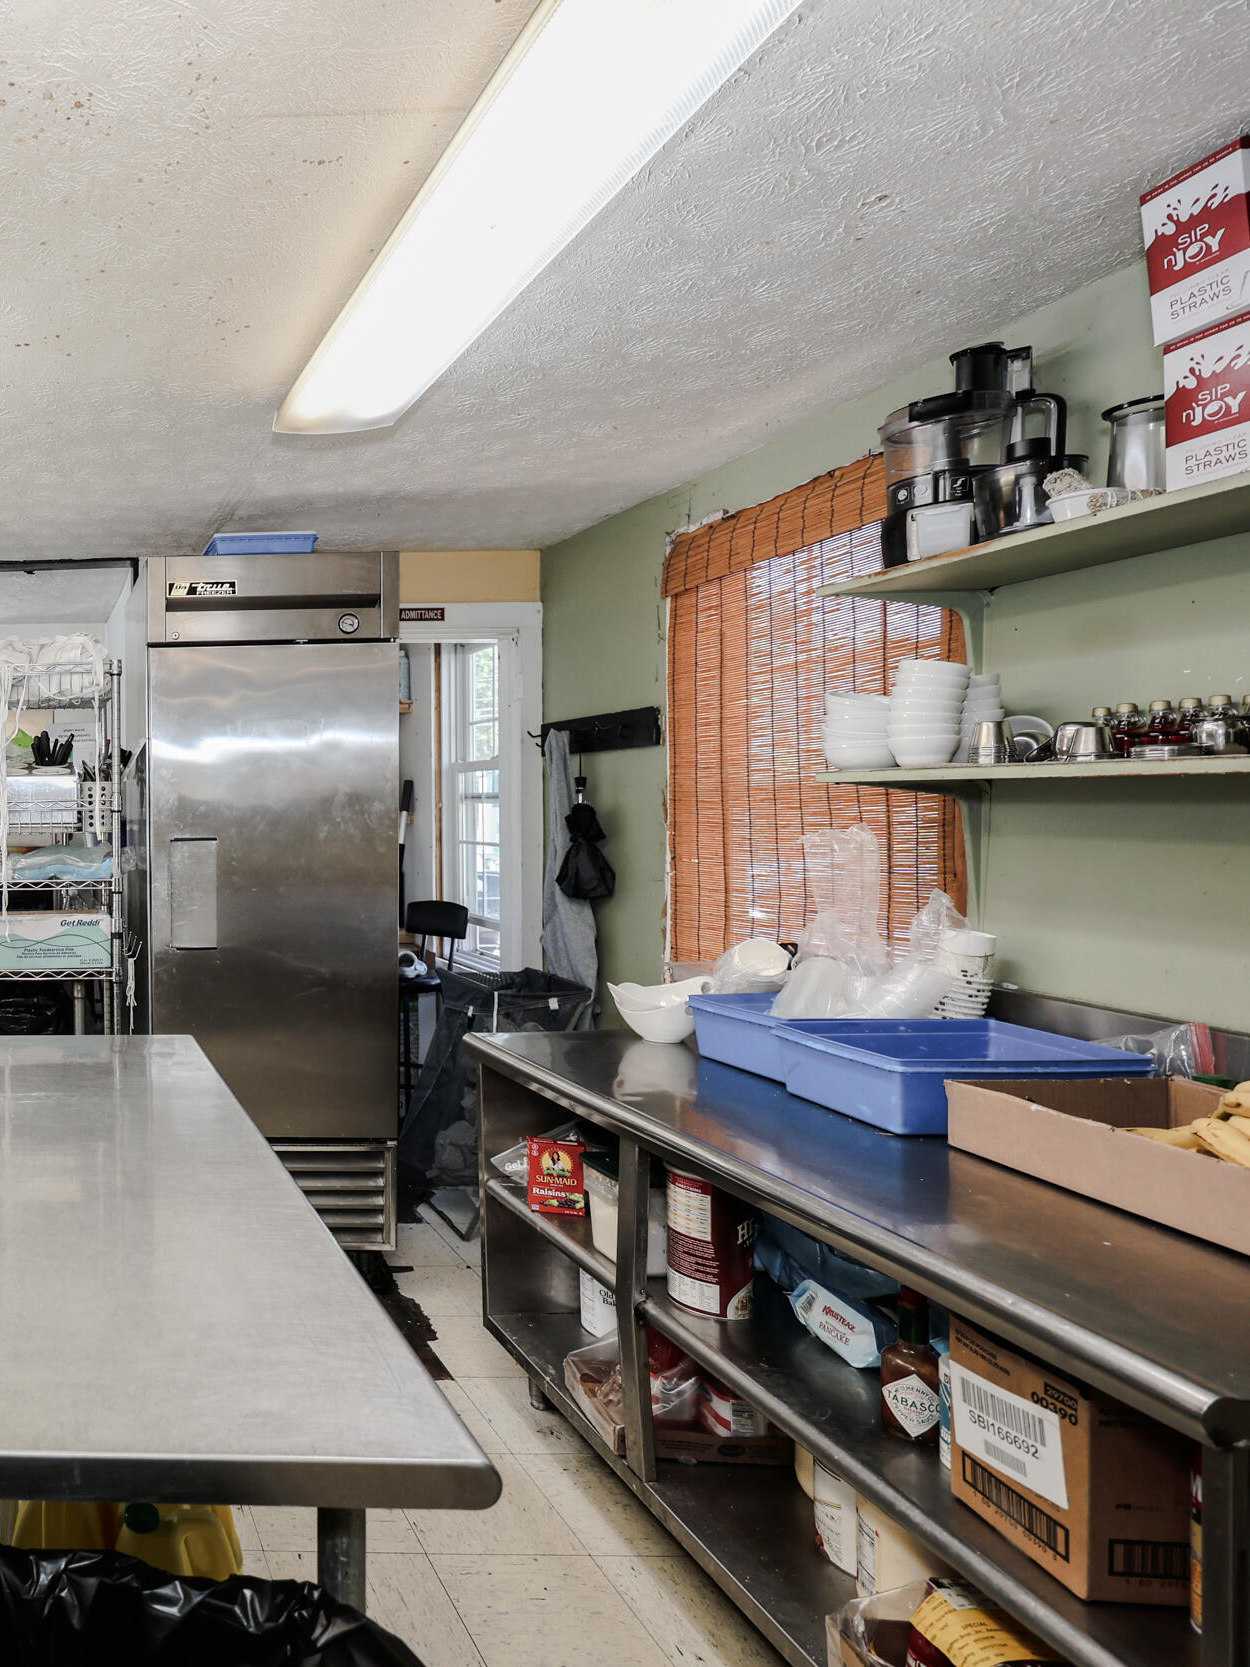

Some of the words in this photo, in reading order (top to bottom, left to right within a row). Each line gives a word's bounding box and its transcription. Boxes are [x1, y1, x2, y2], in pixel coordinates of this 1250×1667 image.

[1178, 224, 1209, 249] SIP
[1170, 275, 1231, 310] PLASTIC
[1170, 285, 1232, 320] STRAWS
[1197, 383, 1230, 405] SIP
[1185, 438, 1247, 465] PLASTIC
[1185, 449, 1248, 475] STRAWS
[400, 610, 443, 620] ADMITTANCE
[60, 919, 76, 927] Get
[77, 919, 100, 927] Reddi
[532, 1187, 566, 1198] Raisins
[599, 1289, 614, 1299] Old
[822, 1305, 857, 1332] KRUSTEAZ
[818, 1321, 852, 1346] PANCAKE
[1030, 1390, 1079, 1427] 00390
[968, 1408, 1040, 1460] SBI166692
